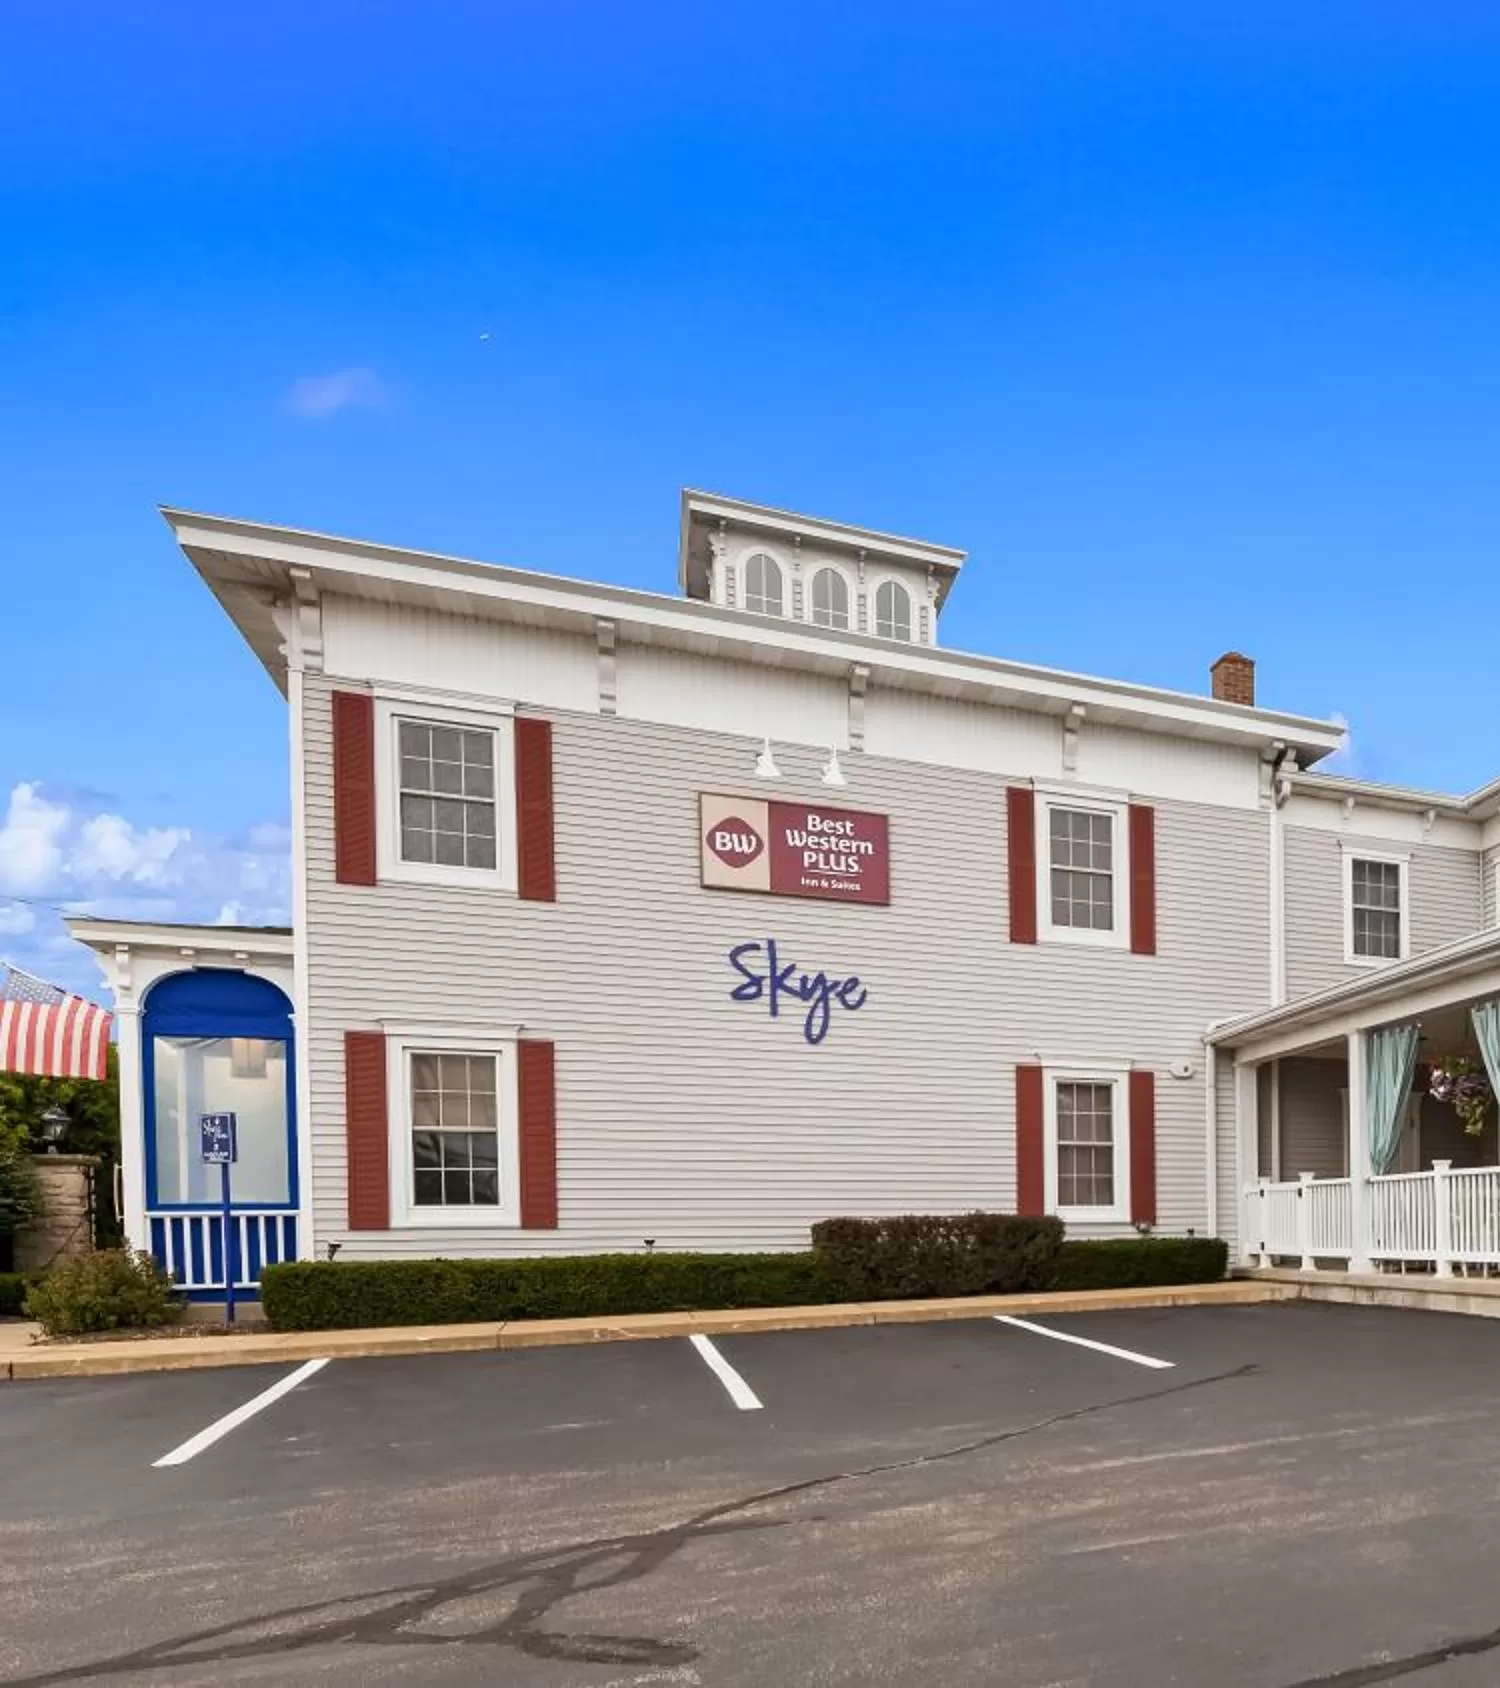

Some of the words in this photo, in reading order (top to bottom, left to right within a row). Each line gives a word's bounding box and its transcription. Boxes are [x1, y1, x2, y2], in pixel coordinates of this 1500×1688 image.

[807, 815, 855, 836] Best
[715, 831, 757, 855] BW
[786, 829, 875, 855] Western
[801, 877, 819, 887] Inn
[729, 938, 867, 1045] Skye
